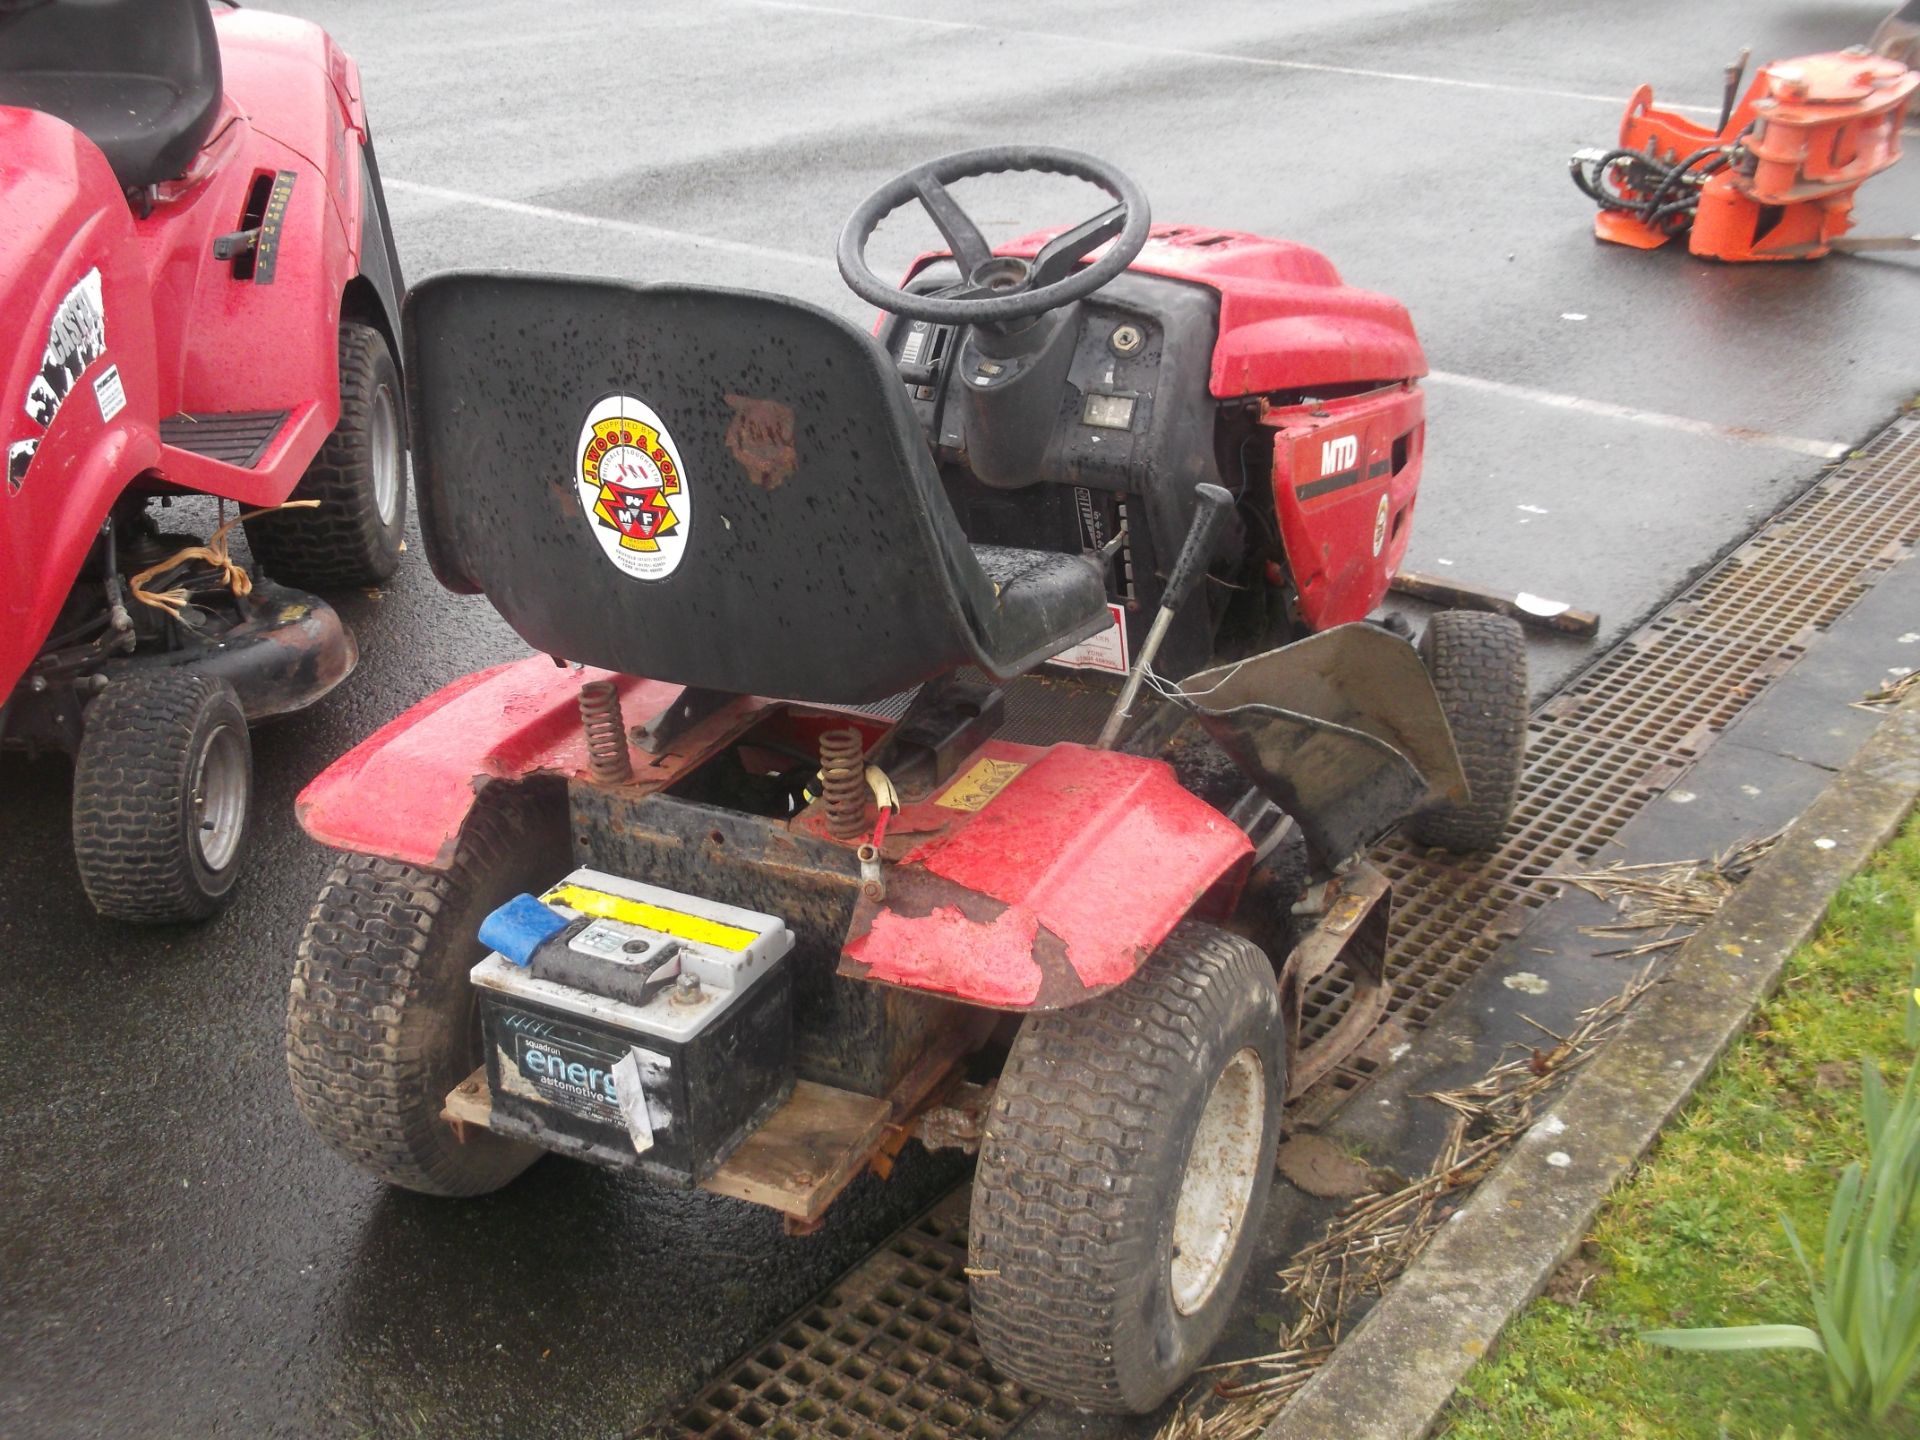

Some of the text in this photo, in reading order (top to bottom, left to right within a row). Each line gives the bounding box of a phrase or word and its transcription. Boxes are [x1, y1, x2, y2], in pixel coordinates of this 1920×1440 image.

[640, 425, 653, 436] BY
[636, 434, 649, 452] &
[652, 448, 678, 488] SON
[1320, 434, 1358, 477] MTD
[525, 1038, 561, 1056] squadron
[540, 1075, 604, 1102] automotive
